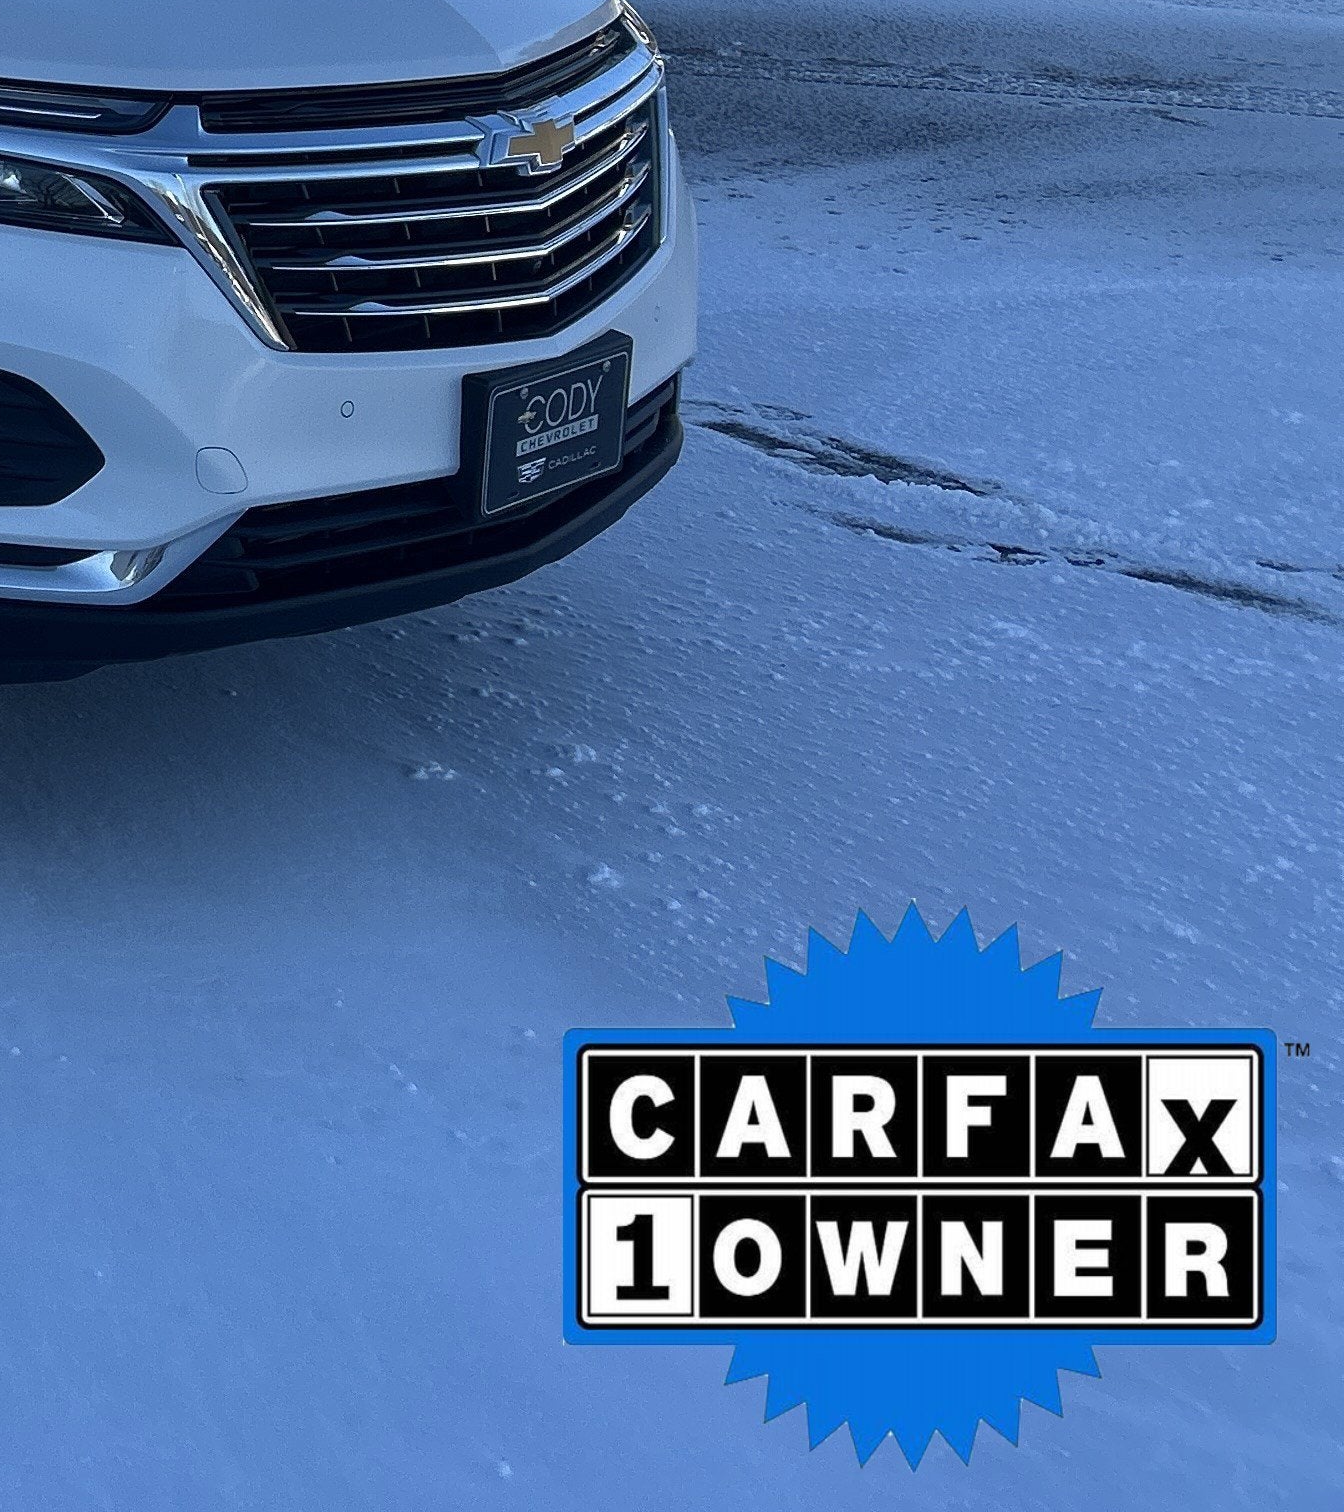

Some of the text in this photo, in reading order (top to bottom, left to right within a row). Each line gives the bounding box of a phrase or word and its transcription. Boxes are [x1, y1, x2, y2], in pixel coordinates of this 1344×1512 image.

[524, 375, 603, 433] CODY
[520, 418, 595, 453] CHEVROLET
[548, 445, 597, 470] CADILLAC
